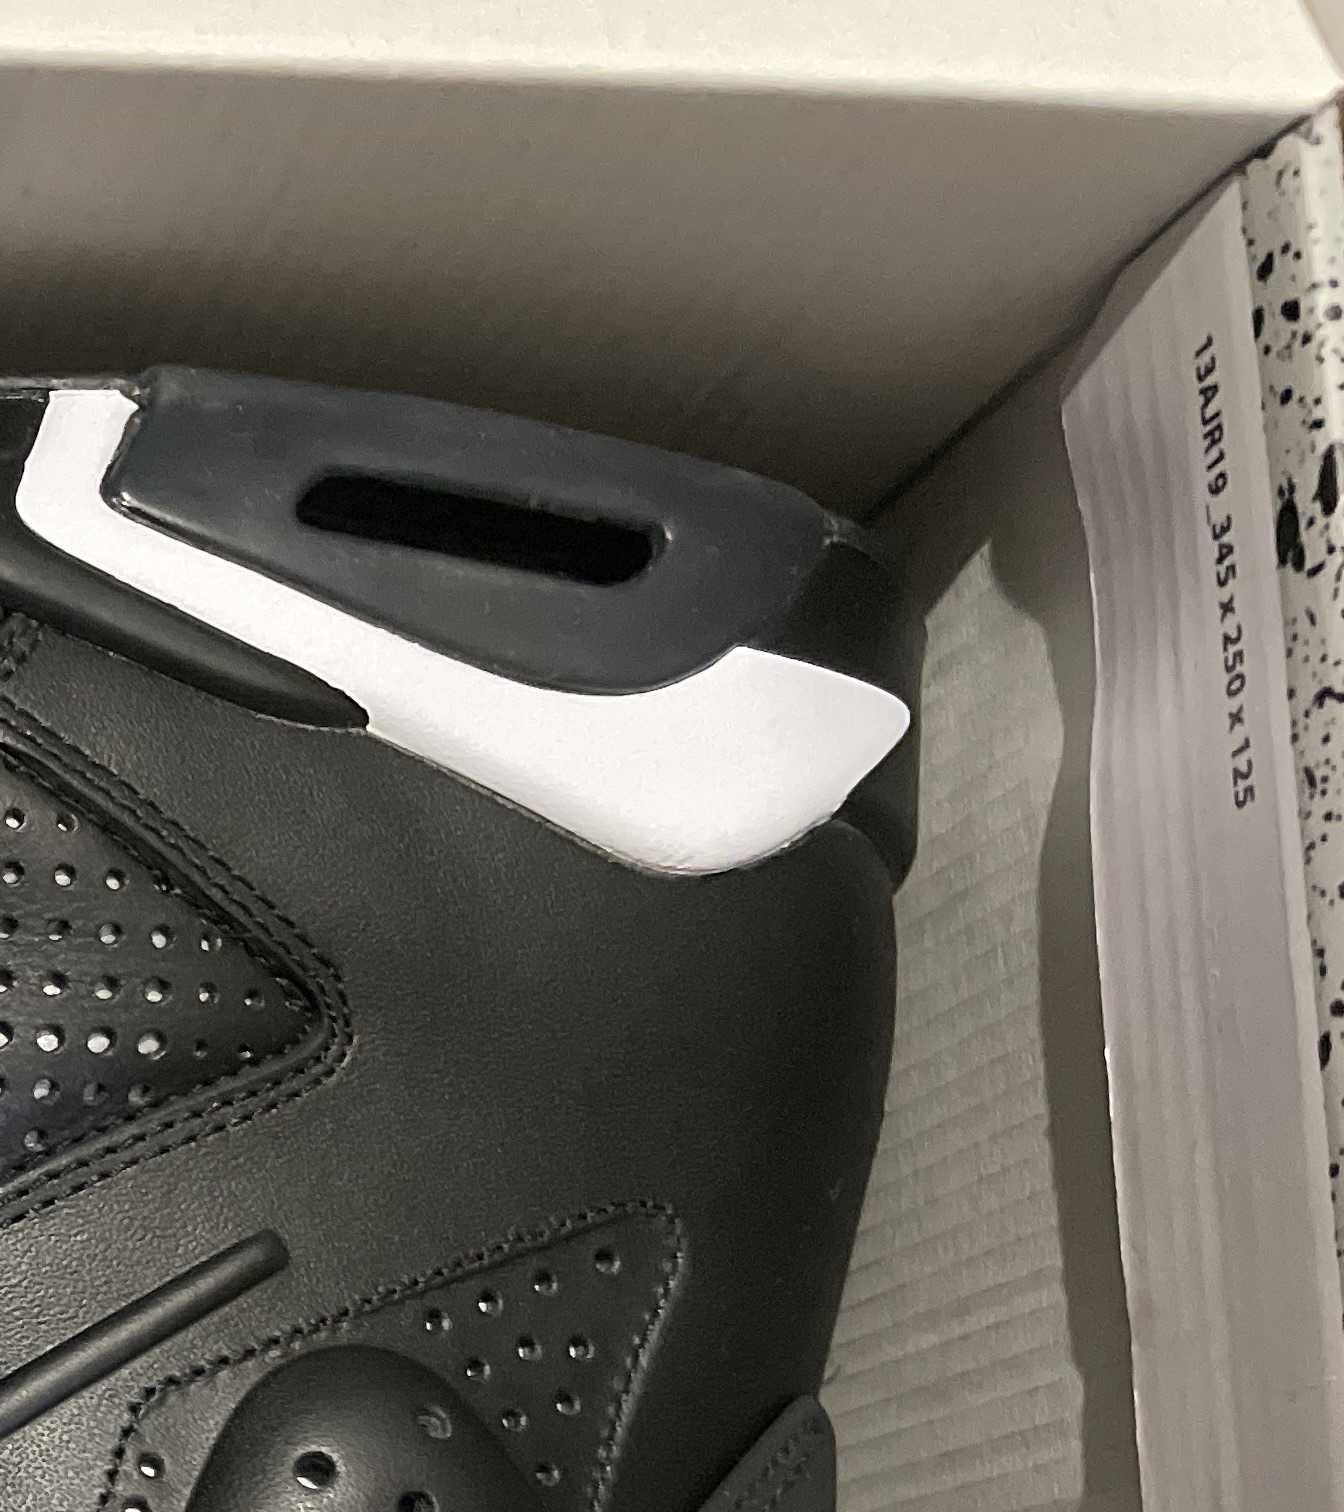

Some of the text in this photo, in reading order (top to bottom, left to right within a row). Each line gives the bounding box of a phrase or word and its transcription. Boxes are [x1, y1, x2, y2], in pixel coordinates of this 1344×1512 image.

[1219, 594, 1237, 623] x
[1223, 624, 1248, 698] 250
[1229, 704, 1246, 731] x
[1232, 738, 1256, 810] 125
